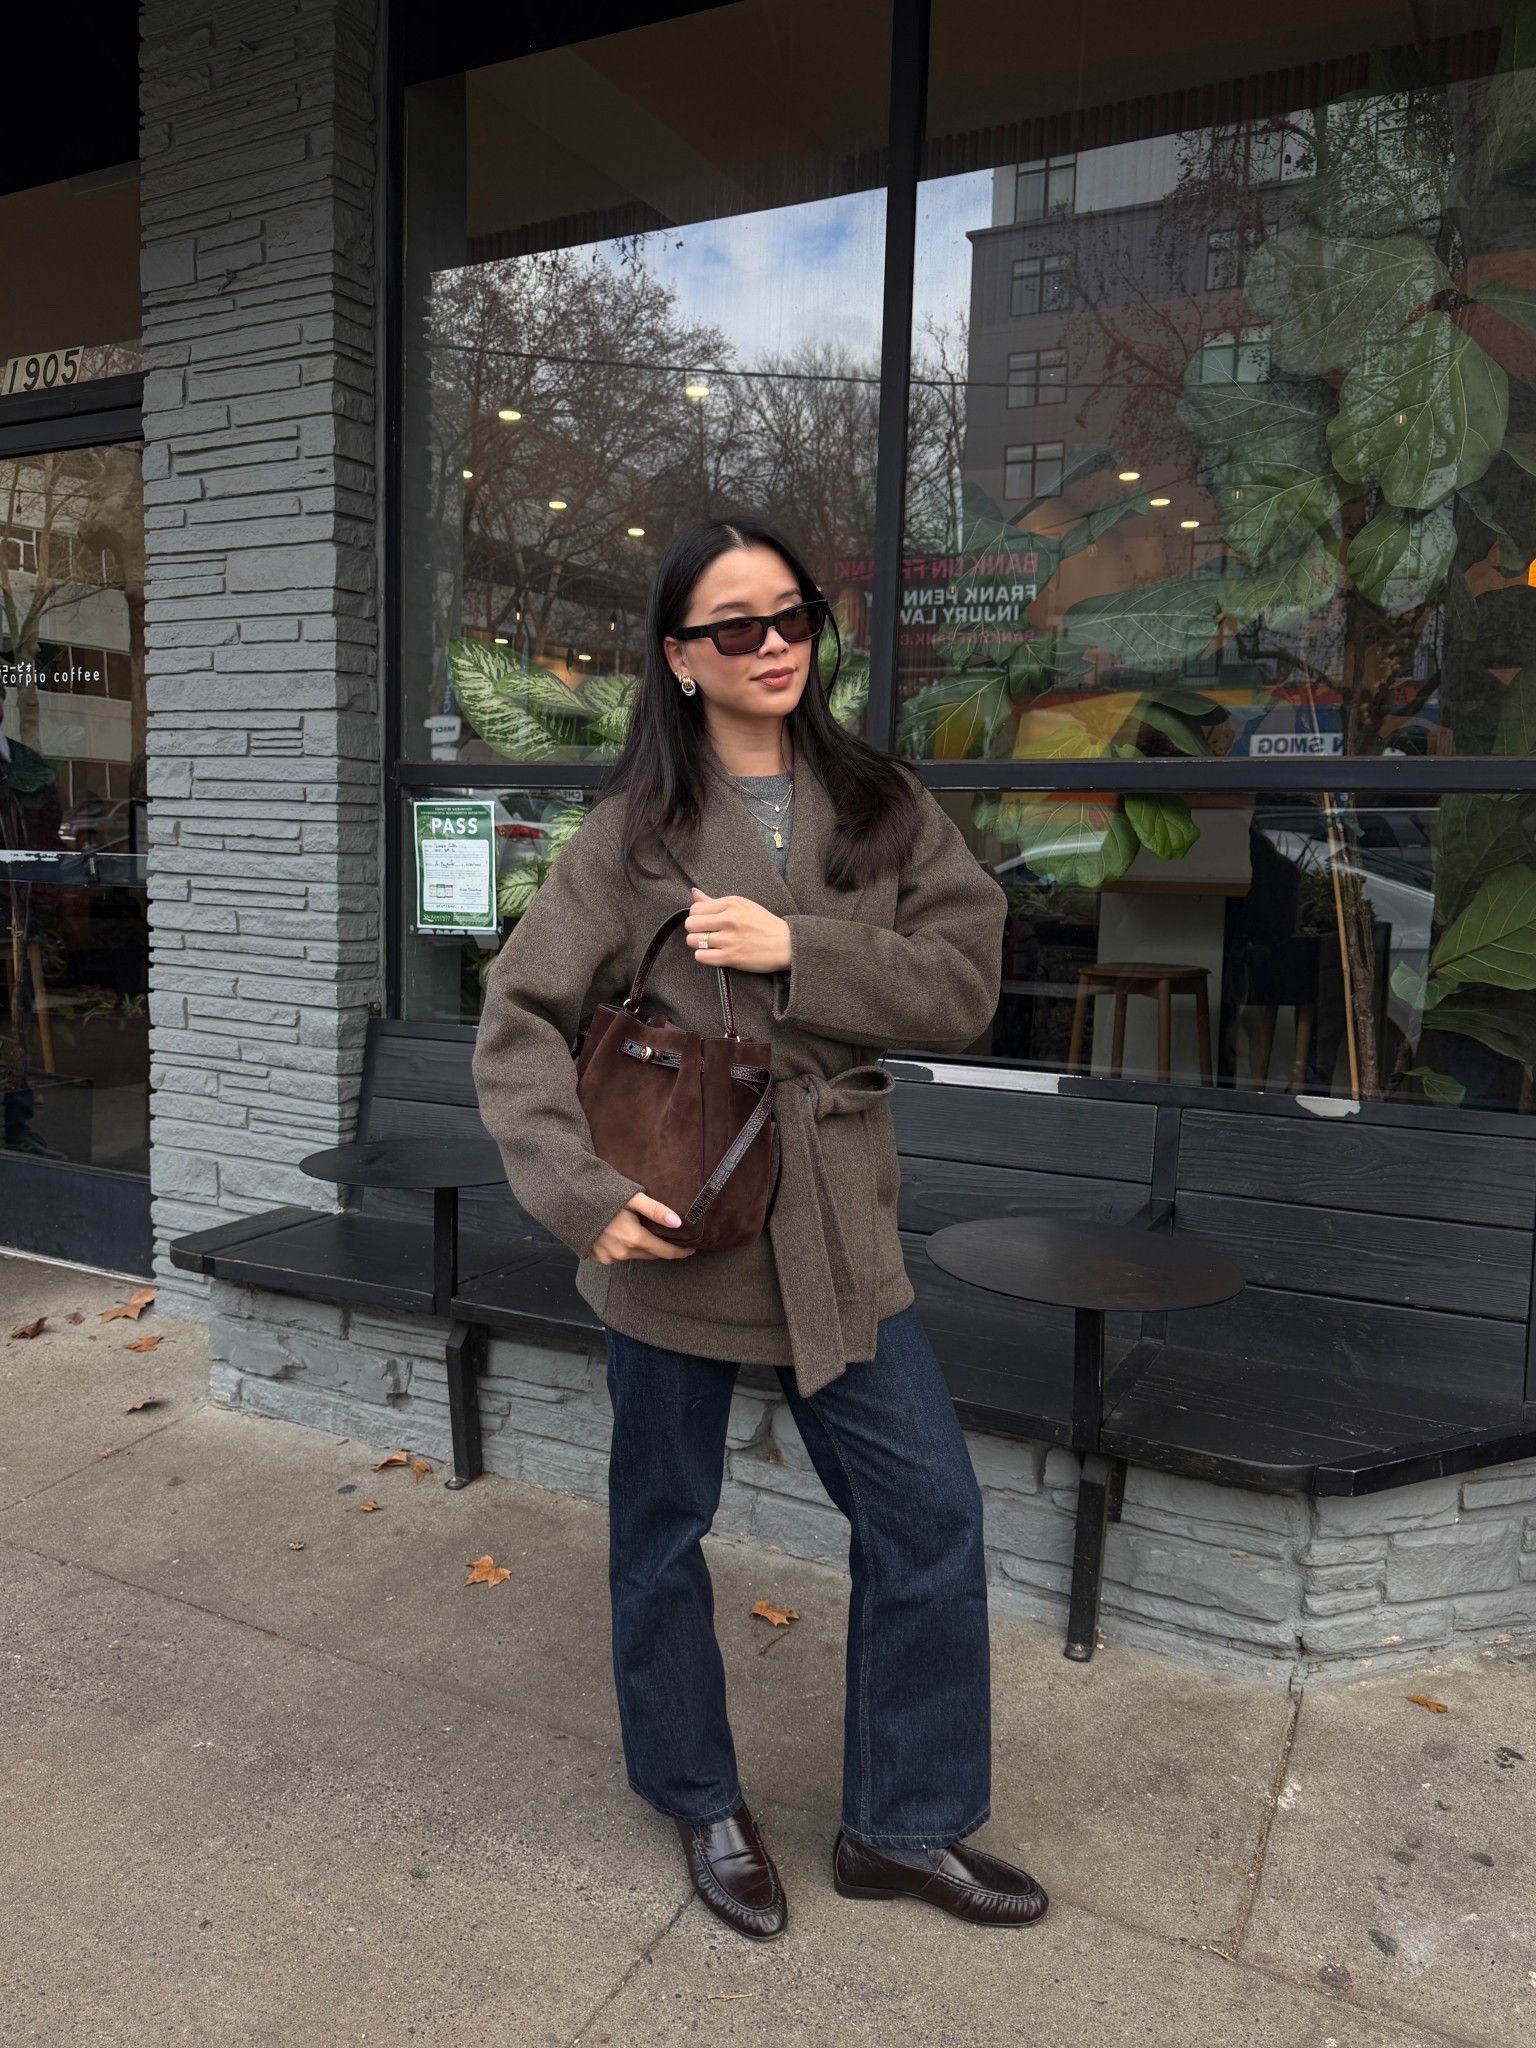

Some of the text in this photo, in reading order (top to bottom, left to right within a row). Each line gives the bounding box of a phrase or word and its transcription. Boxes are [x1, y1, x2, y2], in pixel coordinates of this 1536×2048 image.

[8, 349, 80, 393] 1905
[0, 661, 32, 673] コーピオ
[2, 666, 100, 687] corpio coffee
[431, 817, 478, 835] PASS
